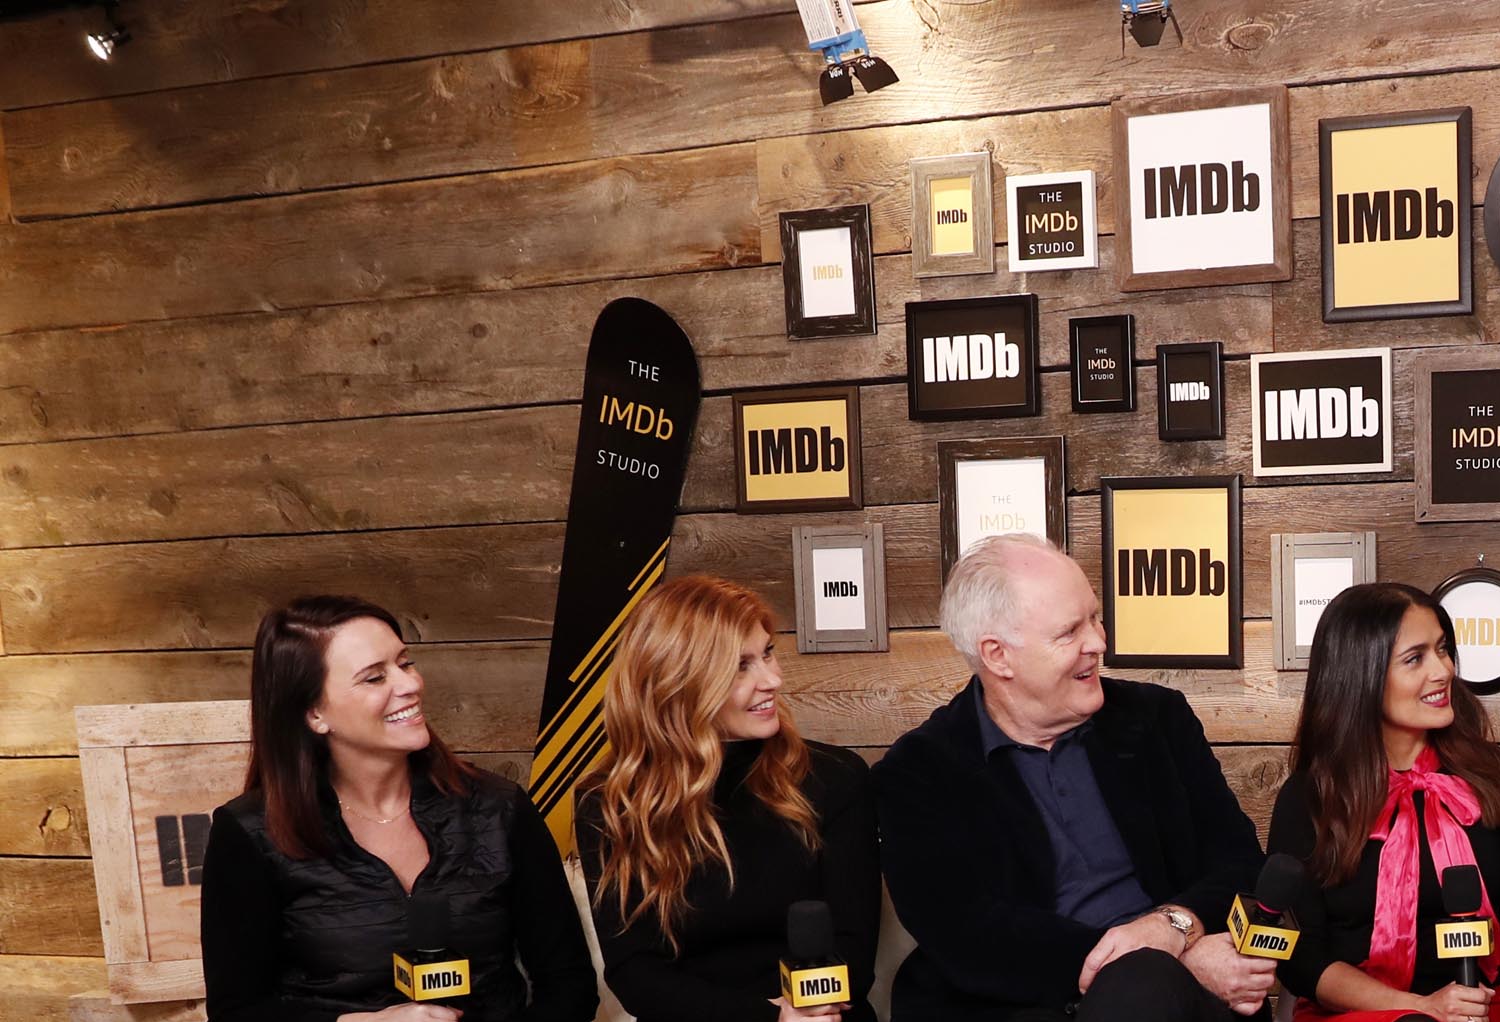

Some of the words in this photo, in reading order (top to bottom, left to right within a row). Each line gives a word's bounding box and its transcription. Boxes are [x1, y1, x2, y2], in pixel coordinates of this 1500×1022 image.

[1039, 191, 1062, 203] THE
[1143, 160, 1261, 219] IMDb
[936, 209, 968, 225] IMDb
[1024, 212, 1079, 235] IMDb
[1337, 187, 1455, 244] IMDb
[1028, 241, 1075, 255] STUDIO
[812, 264, 843, 281] IMDb
[922, 332, 1020, 384] IMDb
[1095, 347, 1107, 355] THE
[628, 360, 660, 382] THE
[1087, 358, 1116, 371] IMDb
[1090, 373, 1114, 381] STUDIO
[1169, 382, 1210, 402] IMDb
[599, 395, 674, 441] IMDb
[1264, 387, 1380, 442] IMDb
[1468, 405, 1494, 417] THE
[748, 426, 845, 475] IMDb
[597, 449, 660, 479] STUDIO
[992, 495, 1012, 504] THE
[980, 513, 1026, 531] IMDb
[1118, 548, 1225, 597] IMDb
[823, 580, 858, 598] IMDb
[1250, 933, 1288, 951] IMDb
[1443, 932, 1482, 949] IMDb
[422, 971, 462, 990] IMDb
[800, 977, 841, 997] IMDb
